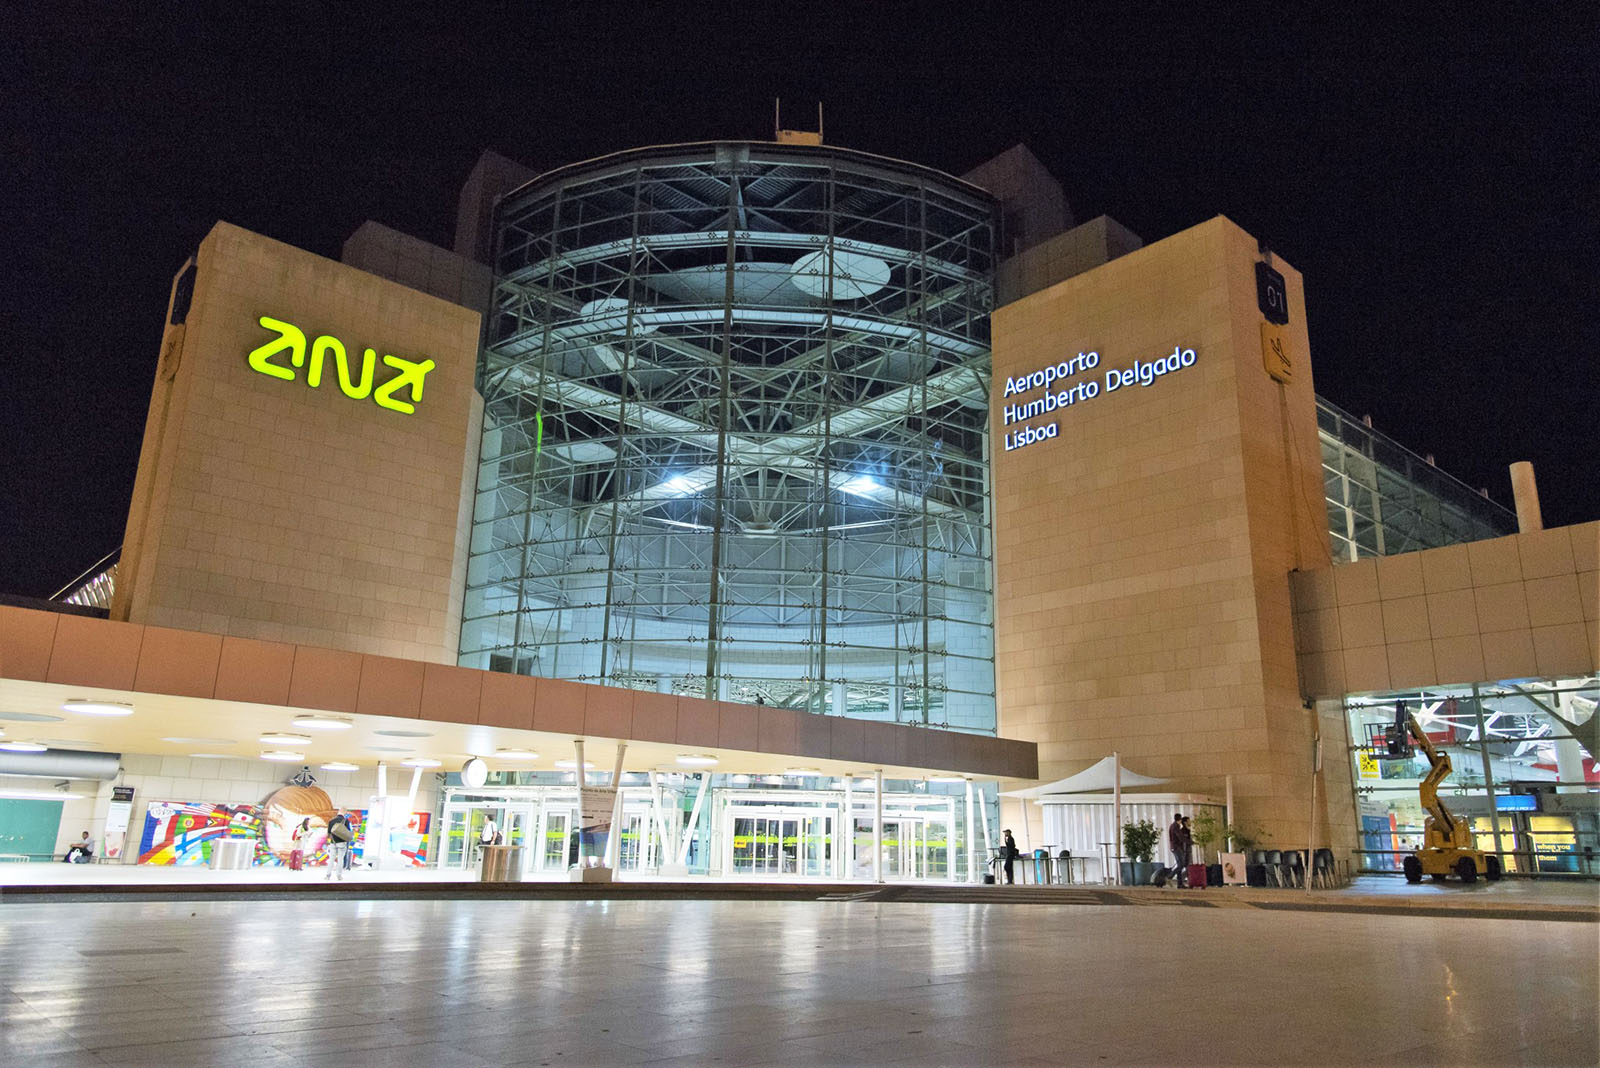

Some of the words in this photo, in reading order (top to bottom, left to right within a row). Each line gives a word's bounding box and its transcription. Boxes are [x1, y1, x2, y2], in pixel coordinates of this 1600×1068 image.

[1003, 351, 1100, 398] Aeroporto
[1003, 381, 1100, 426] Humberto
[1105, 346, 1197, 392] Delgado
[1004, 423, 1059, 451] Lisboa
